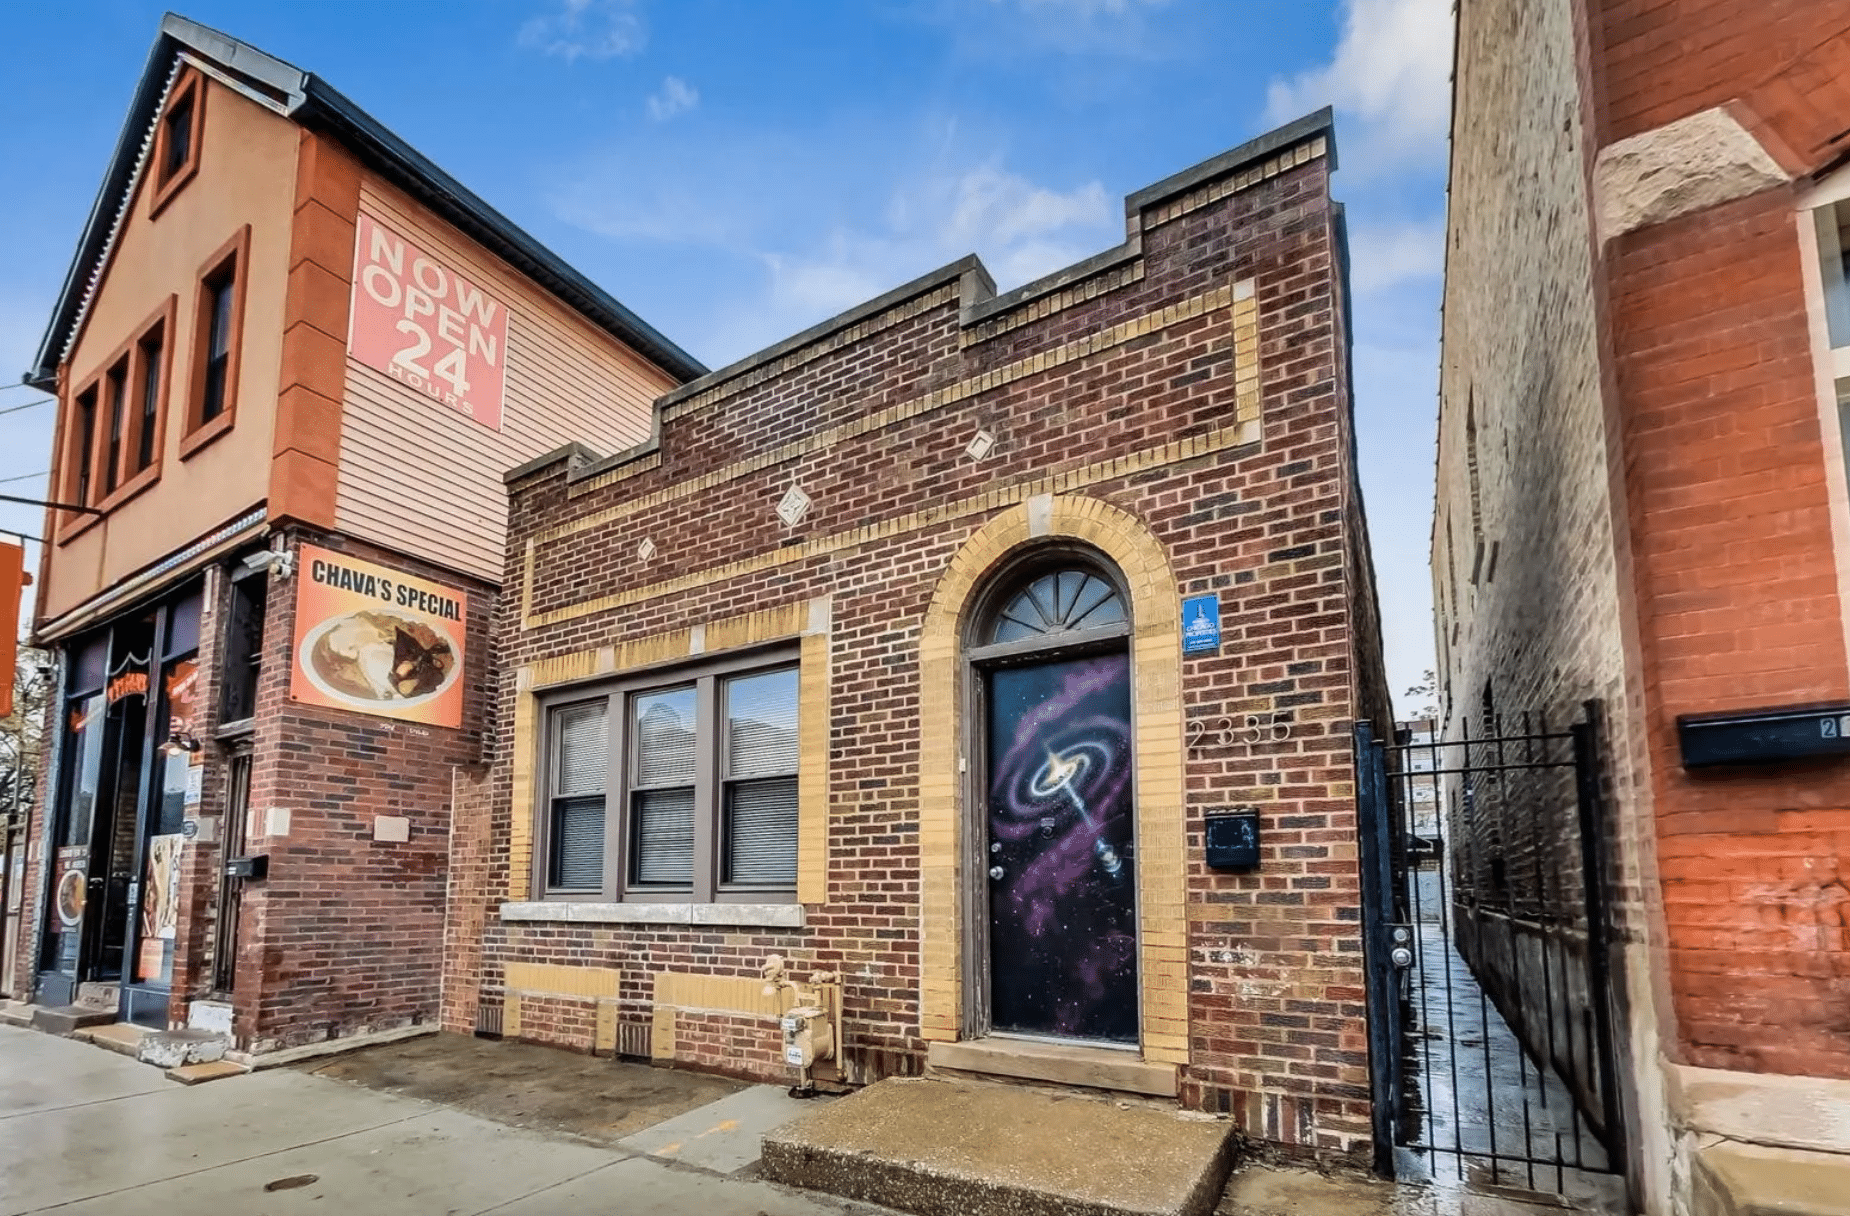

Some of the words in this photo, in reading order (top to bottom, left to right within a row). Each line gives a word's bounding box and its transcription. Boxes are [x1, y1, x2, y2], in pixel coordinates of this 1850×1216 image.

[370, 225, 498, 329] NOW
[362, 264, 497, 367] OPEN
[388, 362, 474, 415] HOURS
[391, 319, 471, 398] 24
[311, 559, 392, 602] CHAVA'S
[396, 584, 462, 622] SPECIAL
[1188, 710, 1291, 749] 2335
